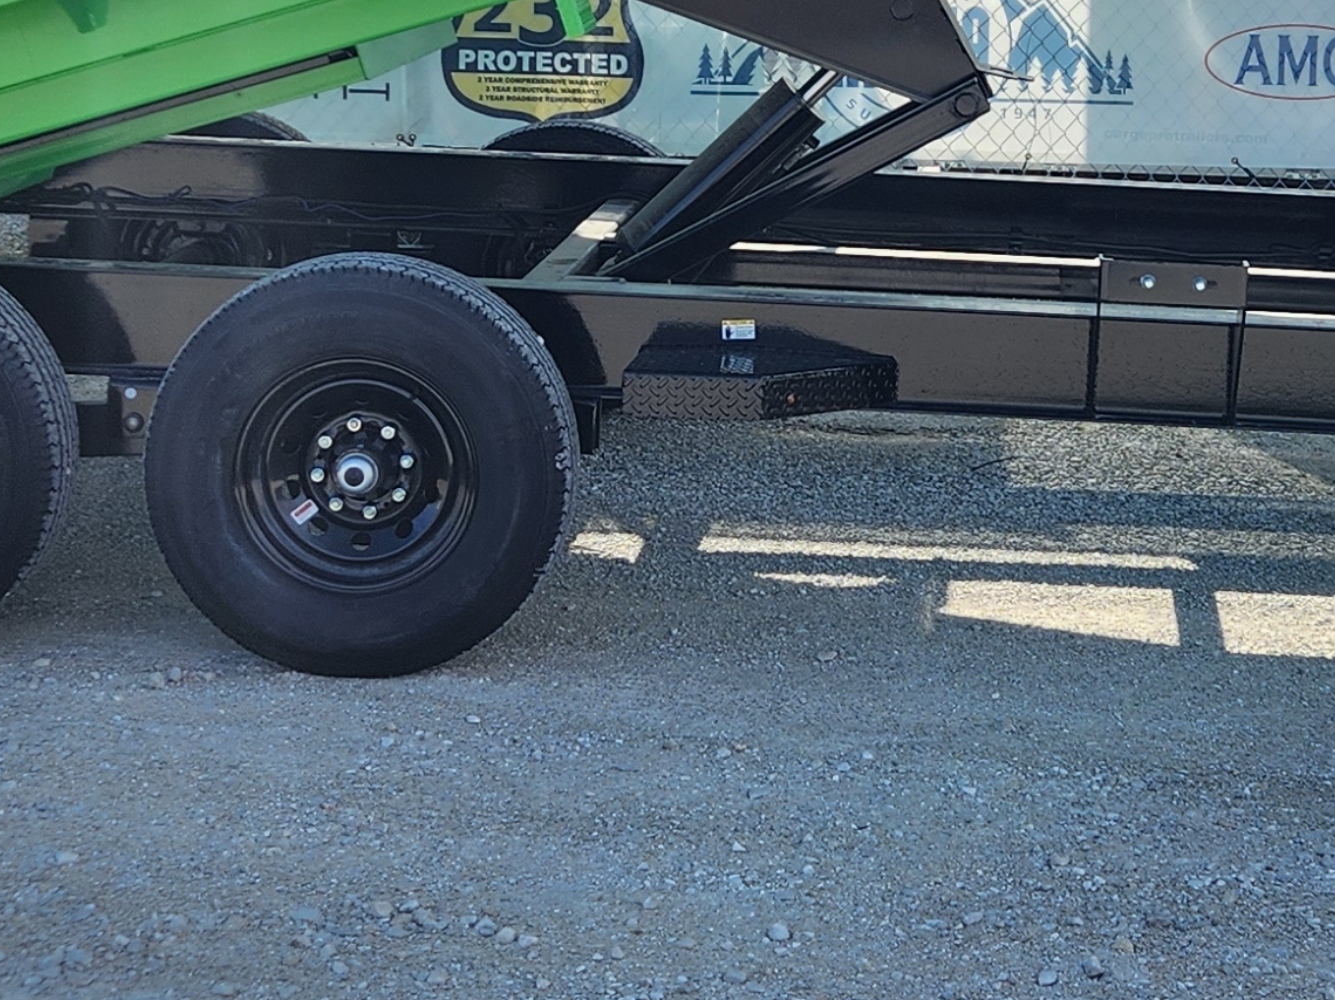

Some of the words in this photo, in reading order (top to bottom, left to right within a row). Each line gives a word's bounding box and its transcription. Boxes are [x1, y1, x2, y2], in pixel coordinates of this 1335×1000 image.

[458, 48, 629, 76] PROTECTED
[513, 86, 559, 94] STRUCTURAL
[999, 107, 1053, 120] 1947
